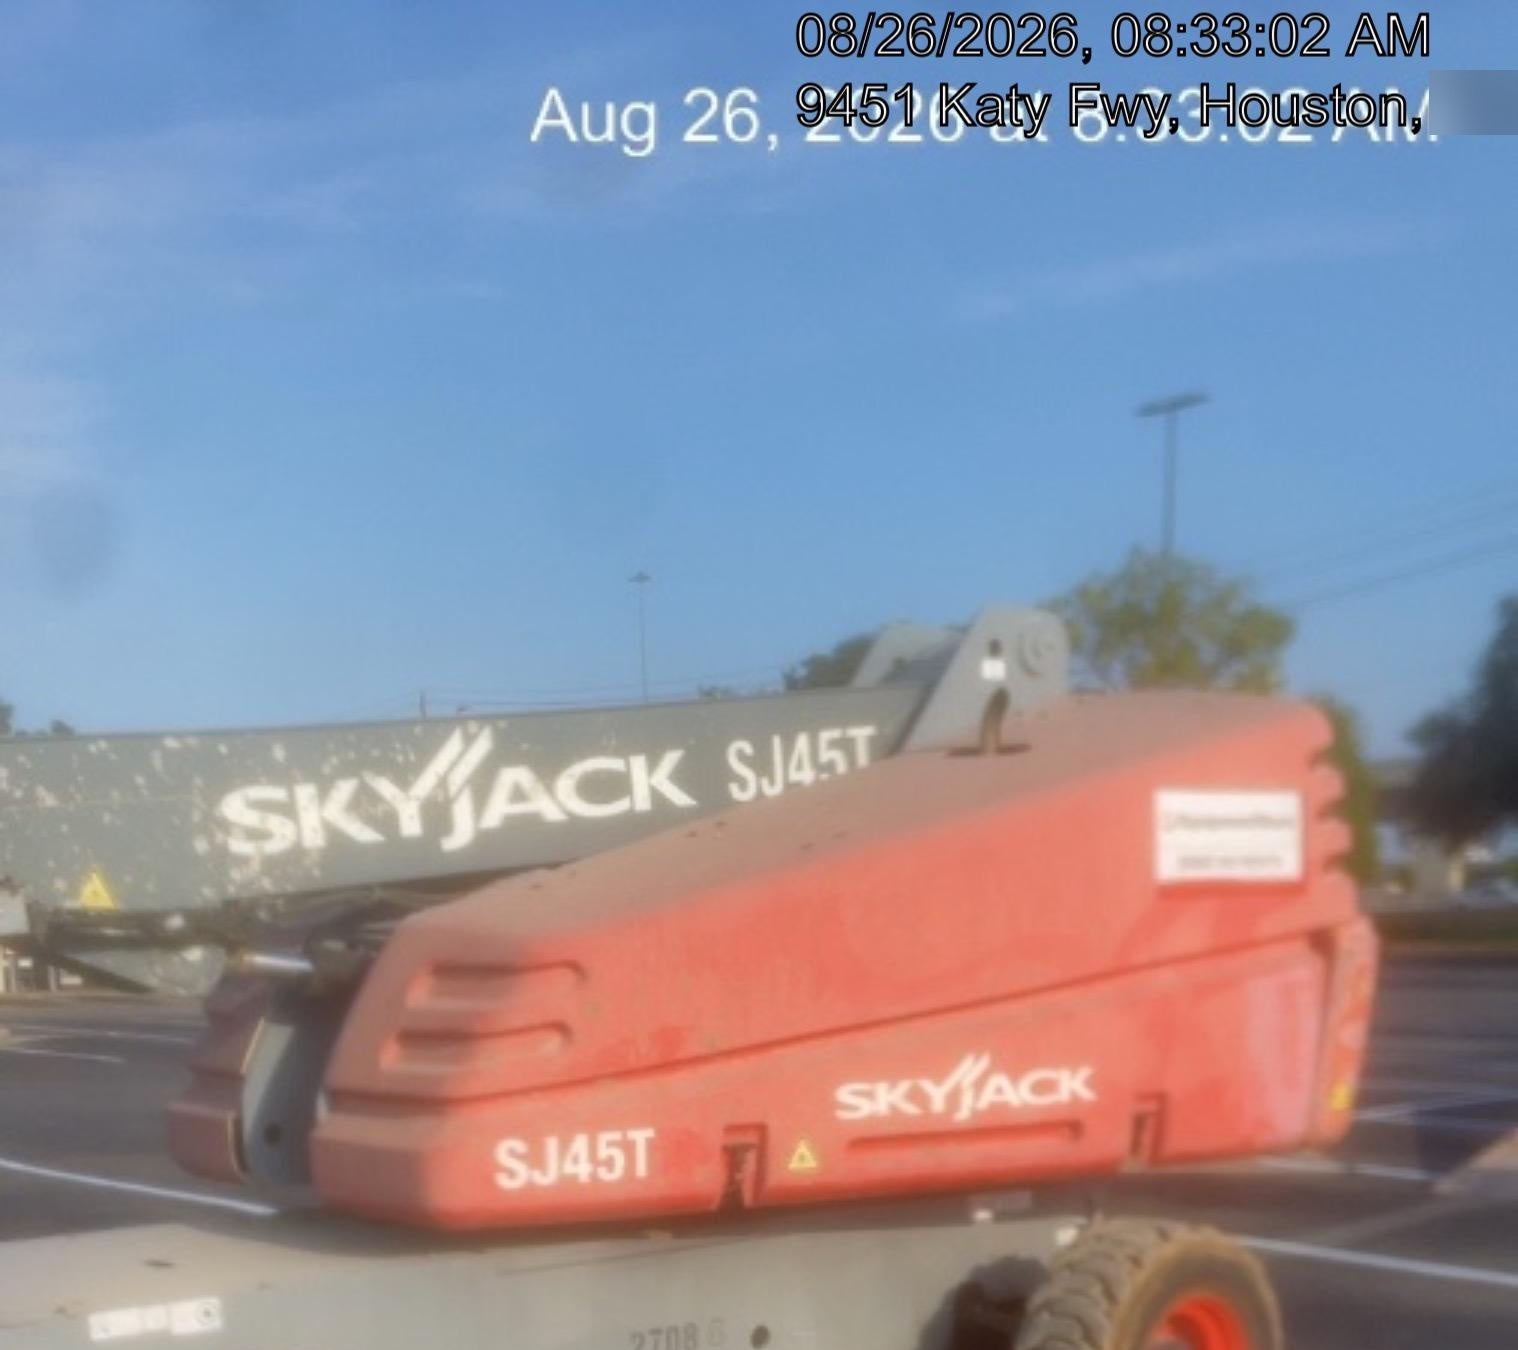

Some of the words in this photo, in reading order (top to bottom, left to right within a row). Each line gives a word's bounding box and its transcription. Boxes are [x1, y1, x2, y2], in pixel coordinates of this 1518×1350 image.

[219, 724, 697, 854] SKYJACK
[726, 725, 876, 802] SJ45T
[833, 1053, 1096, 1121] SKYJACK
[494, 1127, 656, 1191] SJ45T
